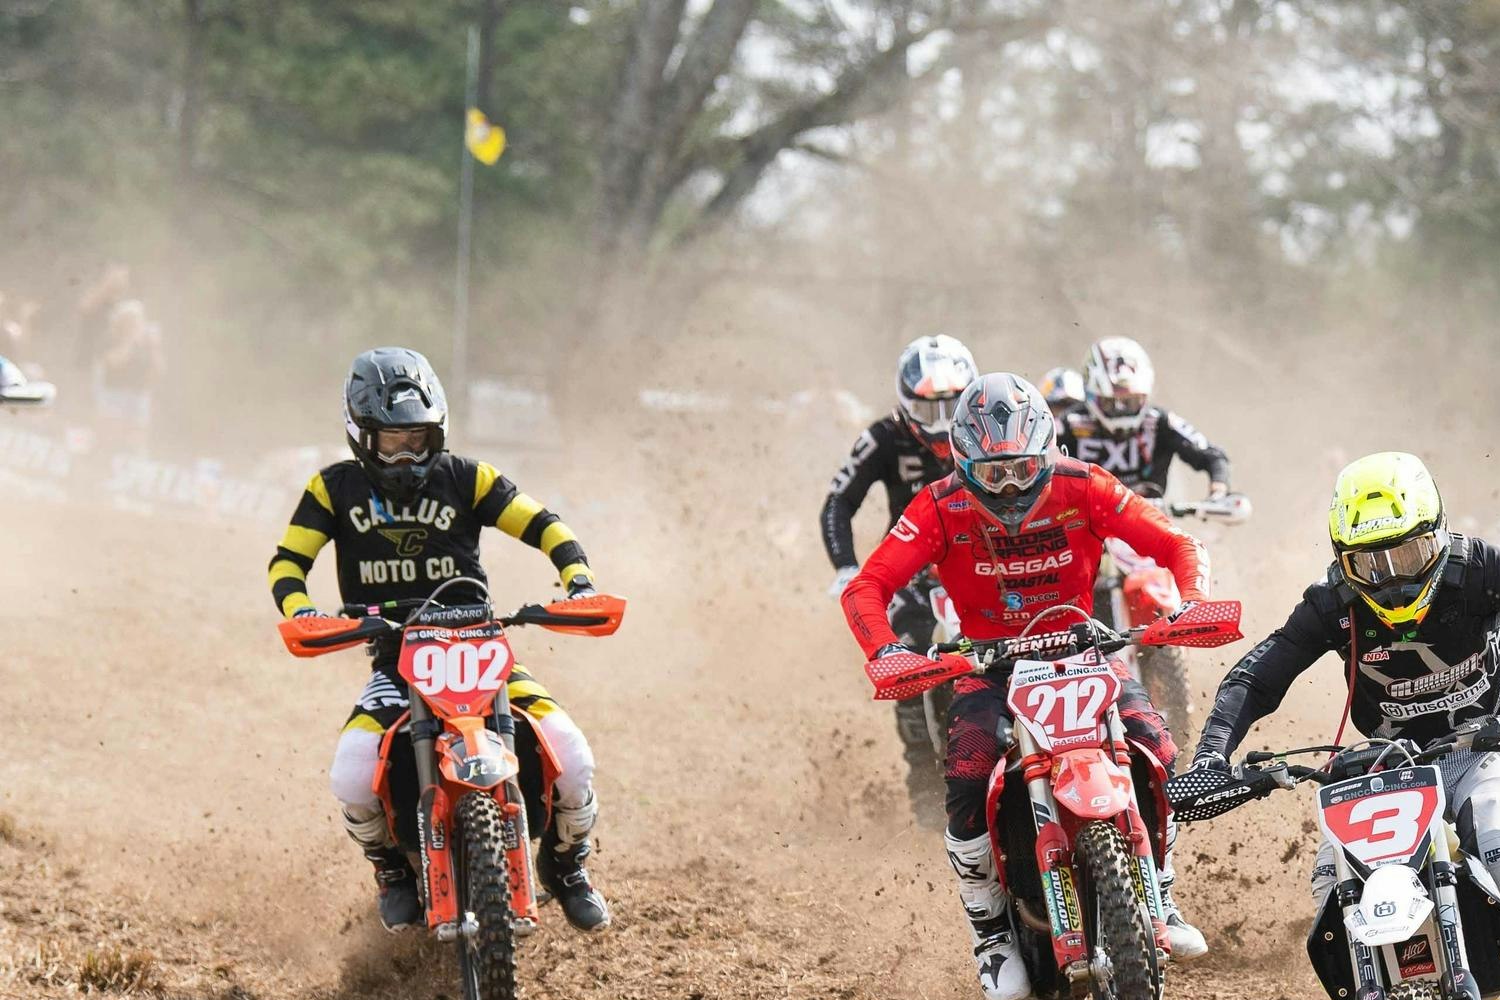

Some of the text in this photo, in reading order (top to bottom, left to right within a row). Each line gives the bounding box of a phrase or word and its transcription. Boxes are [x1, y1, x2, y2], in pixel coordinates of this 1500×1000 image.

[349, 498, 456, 533] CALLUS
[360, 556, 461, 584] MOTO CO.
[975, 550, 1073, 576] GASGAS
[1008, 633, 1078, 654] RENTHA
[413, 641, 508, 696] 902
[1027, 677, 1107, 735] 212
[1405, 678, 1486, 716] Husqvarna
[1053, 734, 1096, 747] GASGAS
[1193, 786, 1251, 806] ACERBIS
[1345, 791, 1424, 863] 3
[1050, 869, 1071, 932] DUNLOP
[1060, 868, 1080, 929] ACERBIS
[1140, 858, 1159, 918] DUNLOP
